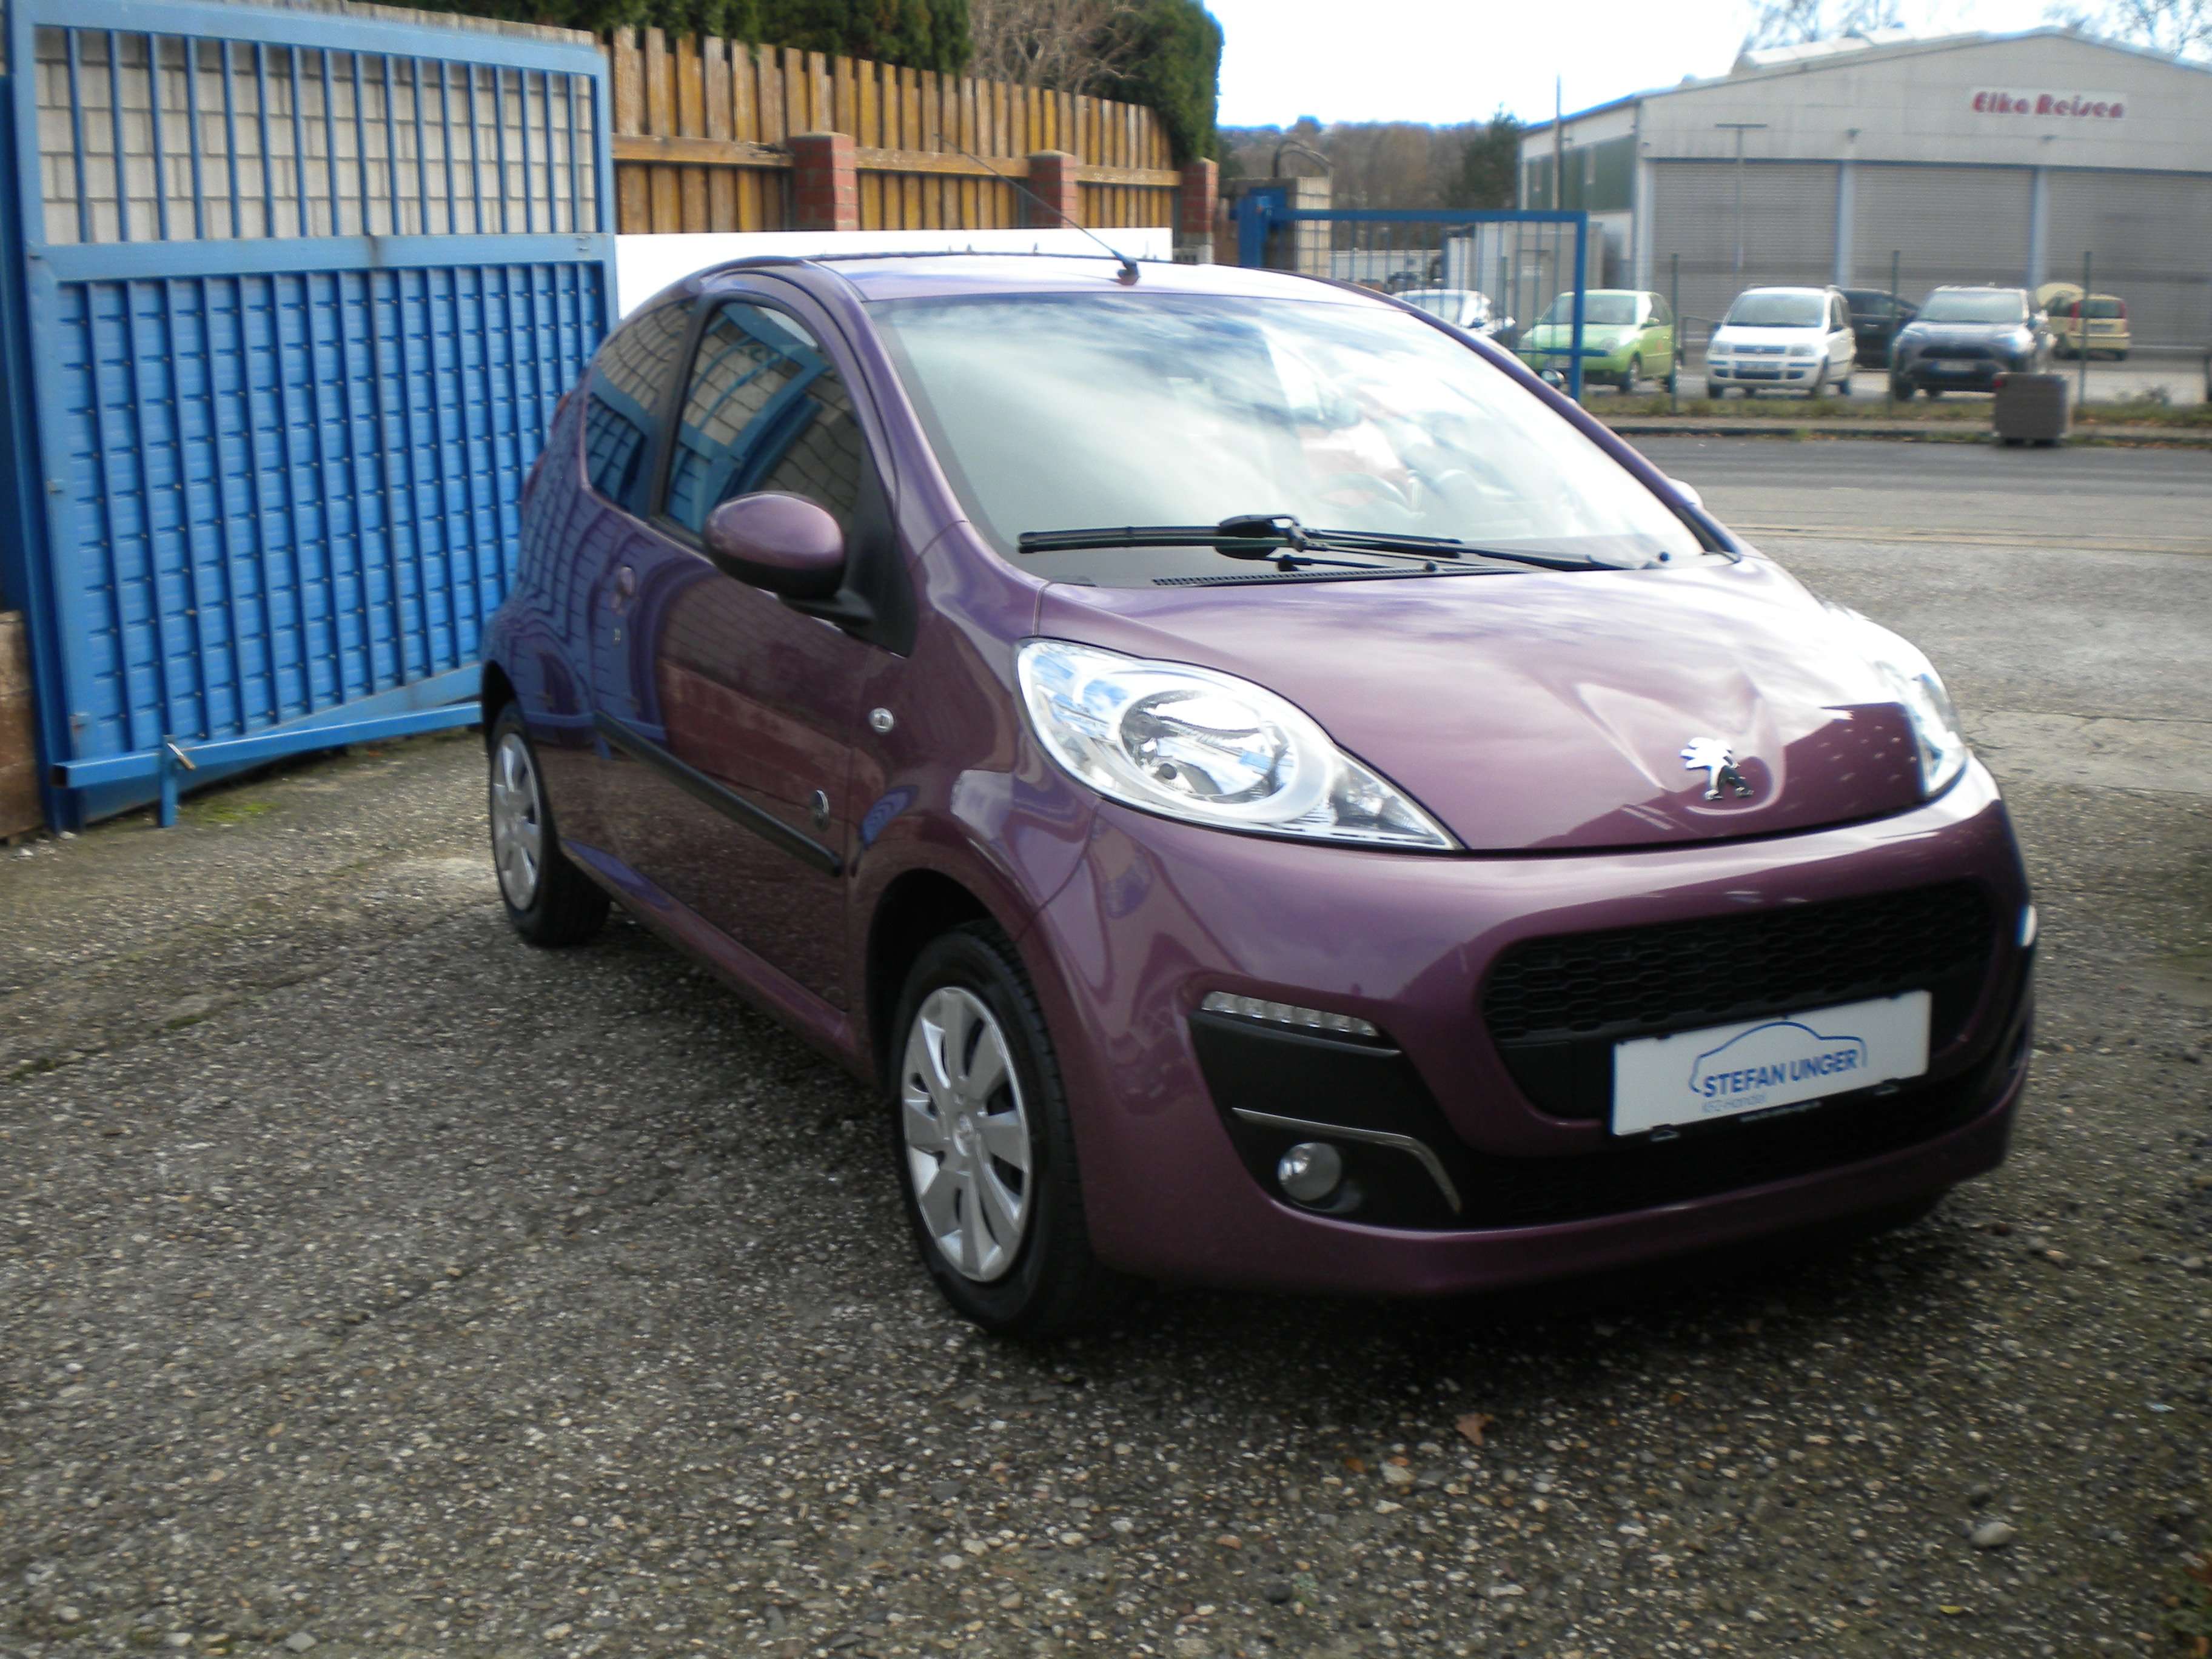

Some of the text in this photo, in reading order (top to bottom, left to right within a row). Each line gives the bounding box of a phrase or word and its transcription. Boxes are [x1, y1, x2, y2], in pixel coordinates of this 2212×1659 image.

[2036, 93, 2123, 118] Reisen
[1704, 1049, 1858, 1098] STEFAN UNGER
